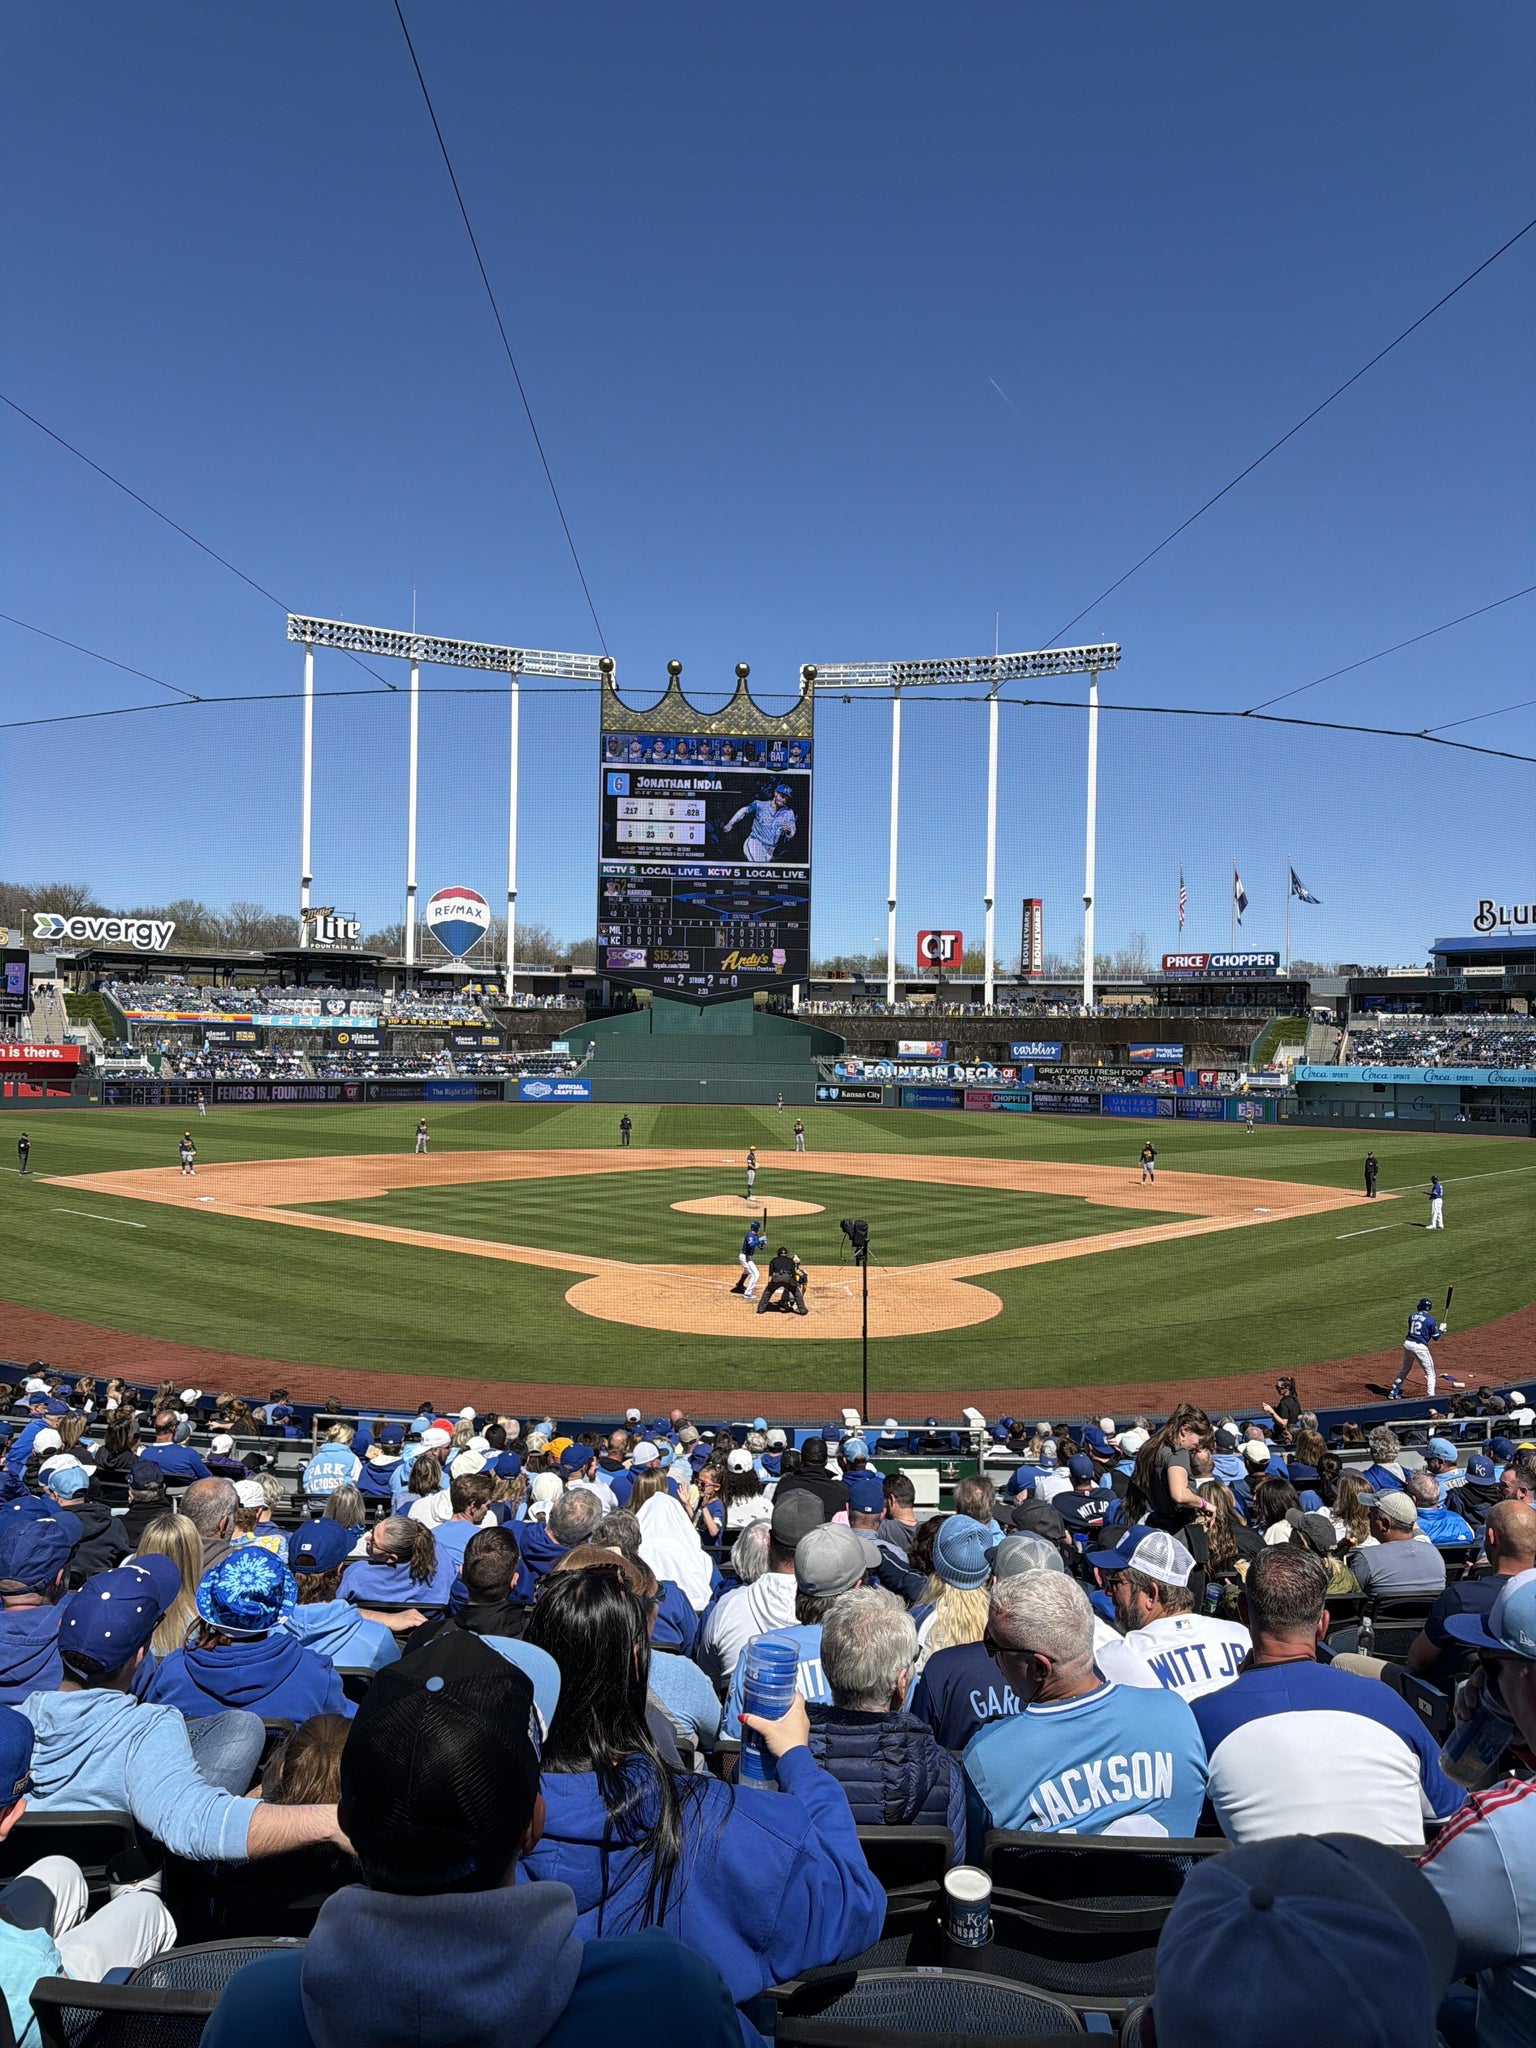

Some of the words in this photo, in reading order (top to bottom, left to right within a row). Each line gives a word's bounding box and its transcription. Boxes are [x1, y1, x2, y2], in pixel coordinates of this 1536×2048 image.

[773, 742, 782, 750] AT
[770, 752, 784, 762] BAT
[614, 777, 622, 792] 6
[637, 776, 690, 789] JONATHAN
[694, 778, 722, 790] INDIA
[301, 907, 334, 923] Miller
[435, 905, 482, 919] RE/MAX
[70, 918, 172, 948] evergy
[314, 916, 361, 944] Lite
[609, 926, 622, 934] MIL
[610, 936, 620, 944] KC
[921, 934, 956, 960] QT
[654, 949, 689, 962] $15,295
[721, 950, 769, 970] Andy's
[1167, 956, 1203, 967] PRICE
[1211, 954, 1274, 966] CHOPPER
[678, 974, 684, 986] 2
[707, 975, 714, 986] 2
[731, 975, 738, 987] 0
[9, 1046, 20, 1057] is
[23, 1046, 63, 1058] there.
[1014, 1042, 1058, 1055] carbliss
[864, 1065, 948, 1078] FOUNTAIN
[954, 1067, 998, 1078] DECK
[1003, 1069, 1014, 1078] QT
[1201, 1073, 1214, 1082] QT
[1301, 1067, 1328, 1079] Circa
[1362, 1067, 1389, 1080] Circa
[1423, 1068, 1452, 1082] Circa
[1488, 1070, 1517, 1084] Circa
[217, 1086, 255, 1100] FENCES
[257, 1086, 270, 1101] IN,
[272, 1086, 326, 1100] FOUNTAINS
[327, 1087, 340, 1099] UP
[867, 1091, 880, 1099] City
[1178, 1099, 1222, 1108] FIREWORKS
[1410, 1321, 1422, 1335] 12
[309, 1463, 346, 1479] PARK
[1476, 1464, 1486, 1476] KC
[1077, 1502, 1096, 1518] WITT
[1147, 1644, 1211, 1689] WITT
[1422, 1702, 1427, 1710] K
[1029, 1752, 1173, 1832] JACKSON
[967, 1913, 982, 1927] KC
